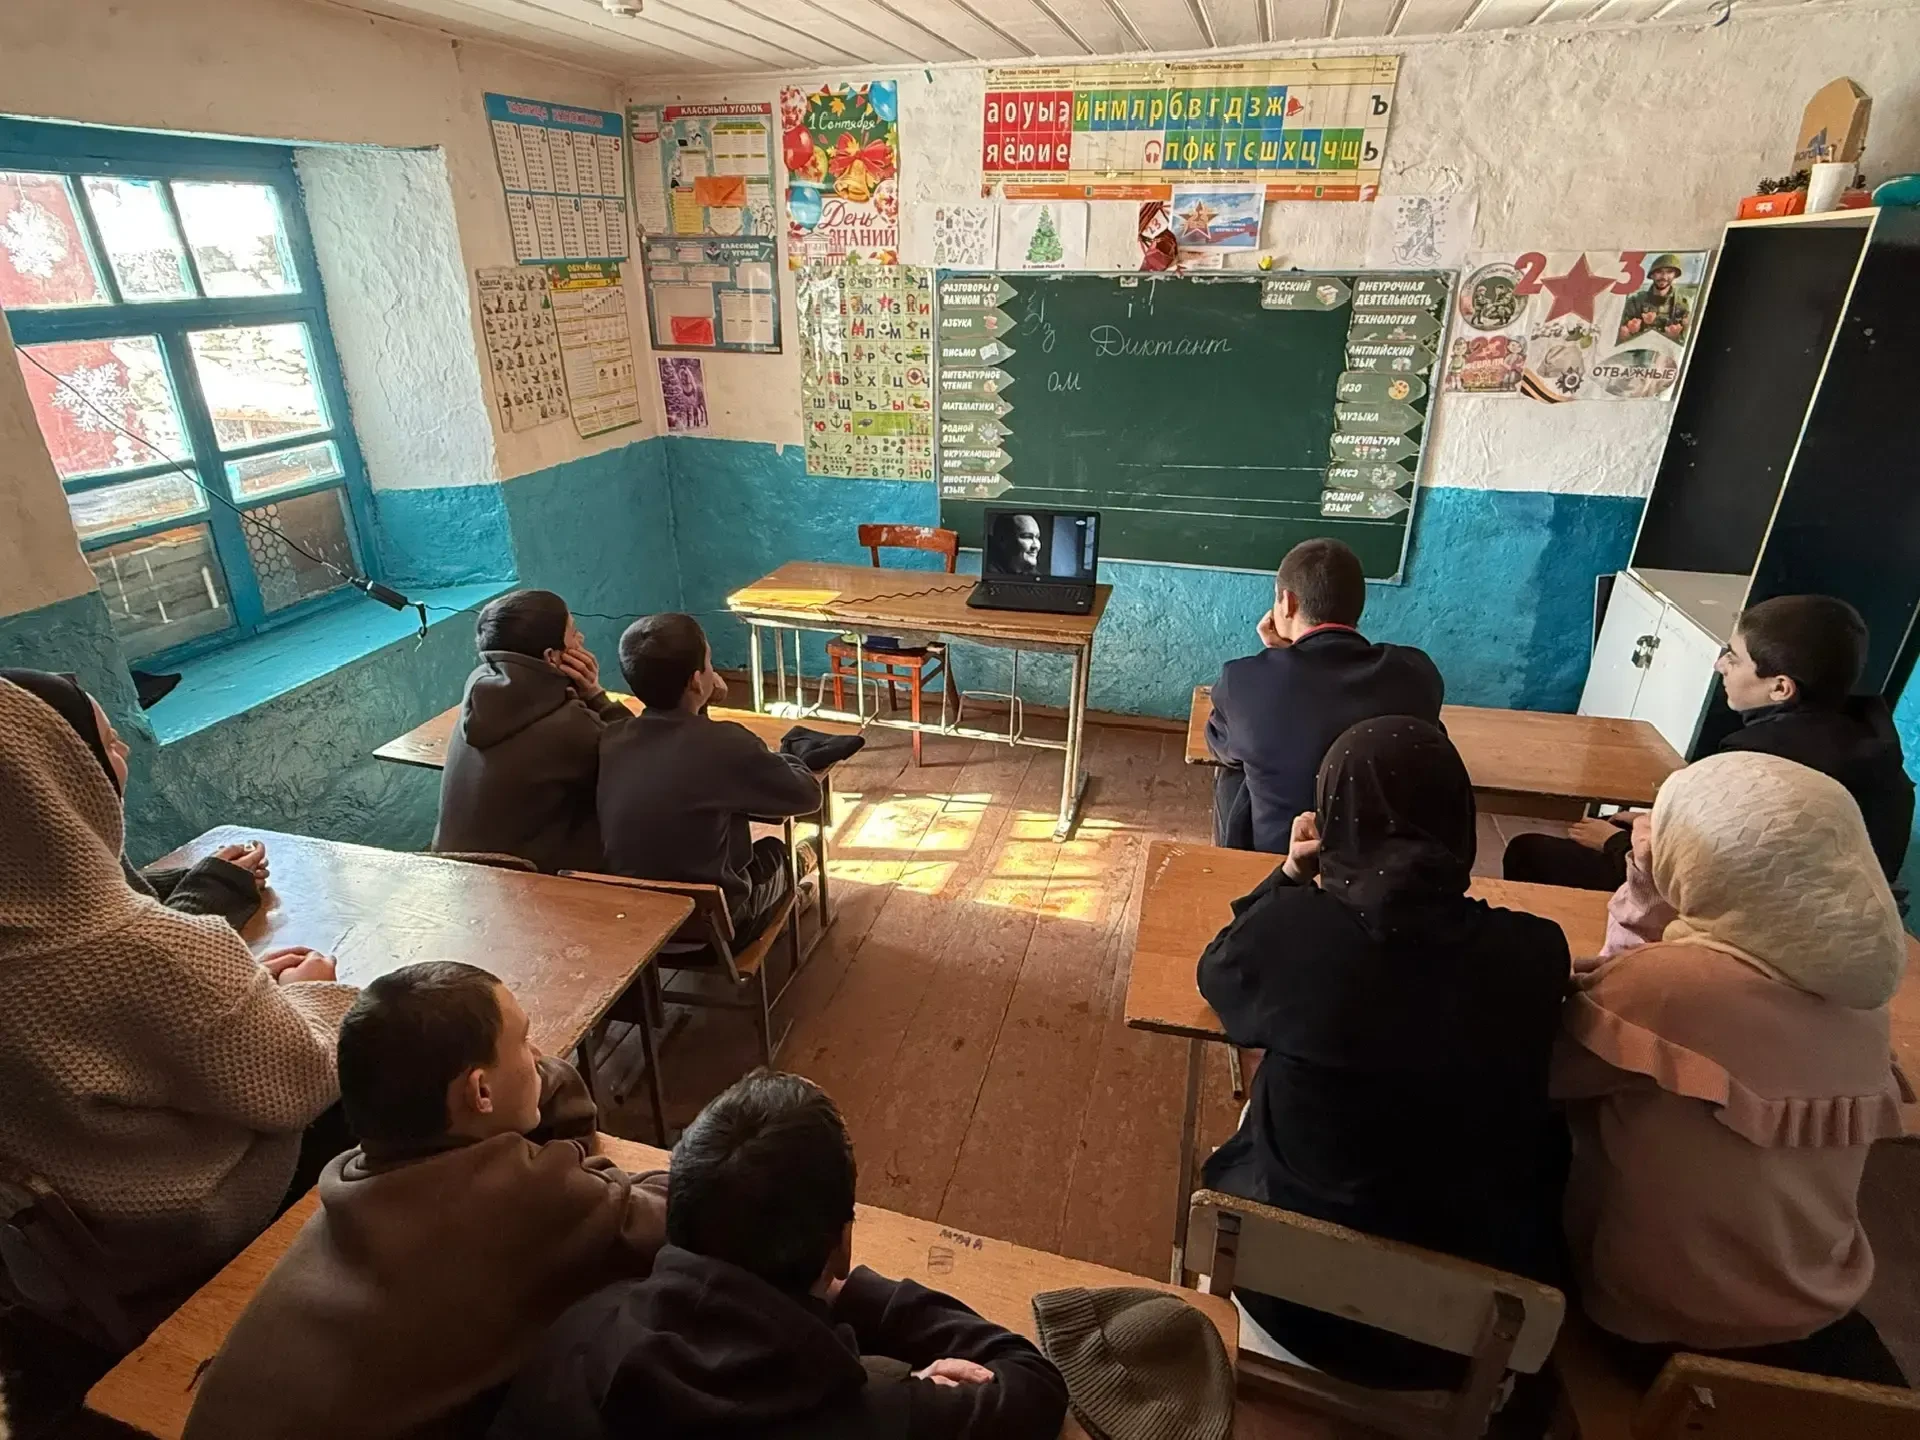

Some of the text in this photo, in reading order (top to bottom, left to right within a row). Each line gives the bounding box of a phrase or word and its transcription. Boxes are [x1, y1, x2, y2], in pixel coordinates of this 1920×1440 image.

[680, 104, 764, 114] КЛАССНЫЙ УГОЛОК
[1038, 102, 1054, 122] ы
[1076, 94, 1089, 121] й
[1094, 101, 1106, 120] н
[1111, 100, 1126, 120] м
[1131, 100, 1144, 120] л
[1150, 99, 1163, 127] р
[1169, 92, 1183, 120] б
[1188, 98, 1201, 118] в
[1209, 98, 1220, 117] г
[1224, 97, 1242, 124] д
[1265, 96, 1284, 117] ж
[808, 112, 816, 130] 1
[539, 128, 547, 142] 2
[564, 132, 572, 146] 3
[589, 136, 596, 148] 4
[613, 140, 620, 151] 5
[986, 144, 998, 163] я
[1004, 137, 1016, 164] ё
[1019, 144, 1034, 163] ю
[1038, 144, 1050, 162] и
[1056, 144, 1068, 162] е
[1166, 142, 1178, 162] п
[1183, 136, 1199, 169] ф
[1203, 142, 1215, 161] к
[1224, 142, 1236, 161] т
[1260, 142, 1278, 161] ш
[1282, 141, 1296, 161] х
[1300, 141, 1316, 166] ц
[1323, 141, 1338, 161] ч
[1340, 141, 1360, 166] щ
[526, 196, 532, 210] 6
[573, 198, 580, 212] 8
[596, 200, 602, 212] 9
[818, 200, 878, 230] День
[828, 226, 896, 246] ЗНАНИЙ
[1513, 252, 1547, 296] 2
[1610, 252, 1646, 295] 3
[918, 278, 929, 290] Д
[943, 283, 1000, 292] РАЗГОВОРЫ О
[1266, 280, 1312, 292] РУССКИЙ
[1358, 282, 1425, 291] ВНЕУРОЧНАЯ
[943, 294, 980, 304] ВАЖНОМ
[1264, 294, 1294, 305] ЯЗЫК
[1354, 295, 1432, 306] ДЕЯТЕЛЬНОСТЬ
[892, 304, 901, 314] З
[919, 304, 930, 314] И
[942, 318, 972, 328] АЗБУКА
[1353, 315, 1417, 324] ТЕХНОЛОГИЯ
[864, 328, 874, 338] Л
[890, 328, 902, 339] М
[920, 328, 930, 338] Н
[1090, 325, 1233, 356] Диктант
[942, 348, 976, 357] ПИСЬМО
[1348, 344, 1414, 356] АНГЛИЙСКИЙ
[1466, 334, 1509, 362] 23
[867, 353, 876, 364] Р
[894, 352, 903, 364] С
[942, 370, 1000, 380] ЛИТЕРАТУРНОЕ
[1592, 364, 1677, 381] ОТВАЖНЫЕ
[867, 376, 876, 387] Х
[893, 377, 904, 388] Ц
[942, 382, 972, 390] ЧТЕНИЕ
[813, 398, 826, 409] Ш
[838, 400, 852, 412] Щ
[892, 400, 904, 411] Ы
[942, 402, 994, 411] МАТЕМАТИКА
[814, 420, 852, 433] Ю Я
[942, 422, 974, 432] РОДНОЙ
[942, 435, 966, 443] ЯЗЫК
[1335, 435, 1400, 446] ФИЗКУЛЬТУРА
[844, 444, 852, 454] 2
[871, 445, 878, 455] 3
[896, 446, 904, 456] 4
[924, 447, 931, 458] 5
[943, 448, 1002, 458] ОКРУЖАЮЩИЙ
[943, 460, 962, 468] МИР
[845, 466, 852, 476] 7
[872, 467, 879, 478] 8
[898, 468, 904, 478] 9
[920, 468, 932, 480] 10
[1328, 468, 1359, 478] ОРКСЭ
[942, 474, 1000, 484] ИНОСТРАННЫЙ
[942, 486, 966, 494] ЯЗЫК
[1325, 491, 1364, 502] РОДНОЙ
[1324, 503, 1352, 512] ЯЗЫК
